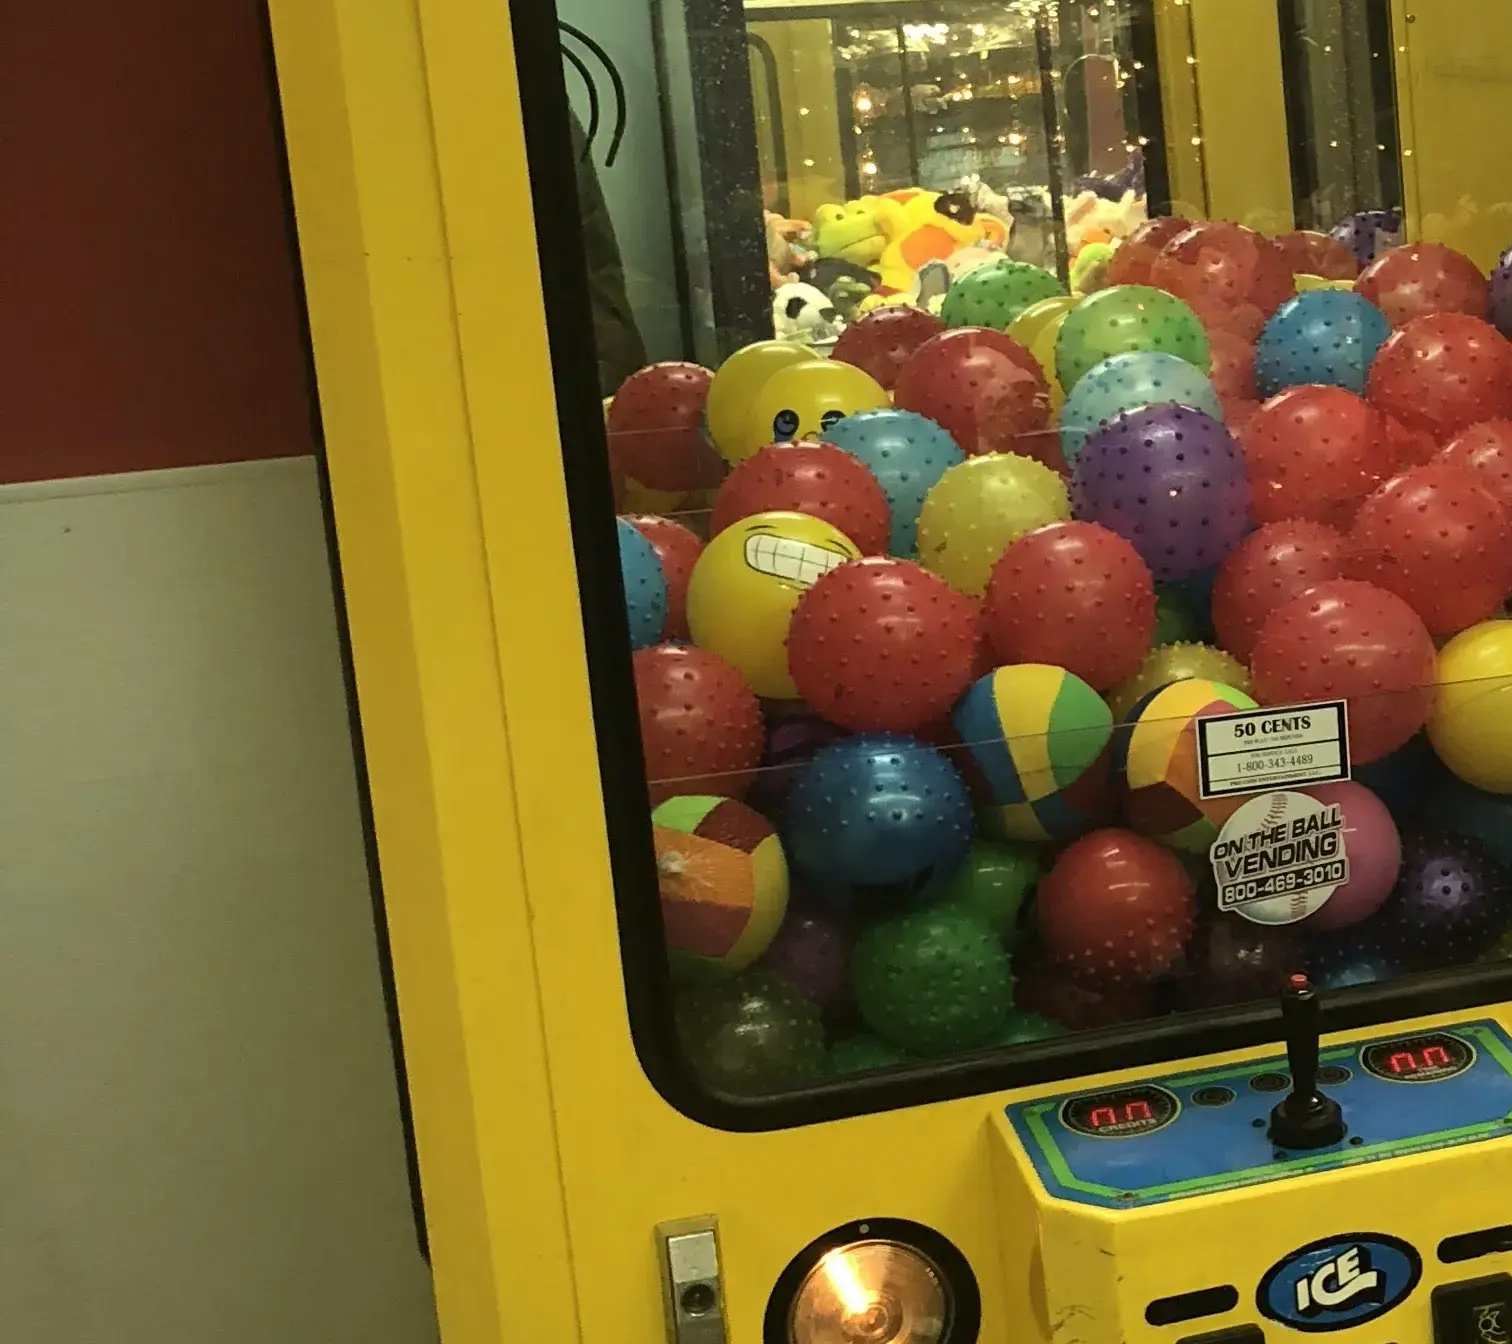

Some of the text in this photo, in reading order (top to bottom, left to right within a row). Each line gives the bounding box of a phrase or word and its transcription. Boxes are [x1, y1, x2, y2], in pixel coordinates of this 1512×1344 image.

[1234, 715, 1311, 738] 50 CENTS
[1237, 753, 1314, 773] 1-800-343-4489
[1213, 807, 1342, 860] ON THE BALL
[1224, 831, 1339, 881] VENDING
[1224, 862, 1343, 903] 800-469-3010
[1098, 1117, 1157, 1134] CREDITS
[1296, 1247, 1378, 1312] ICE
